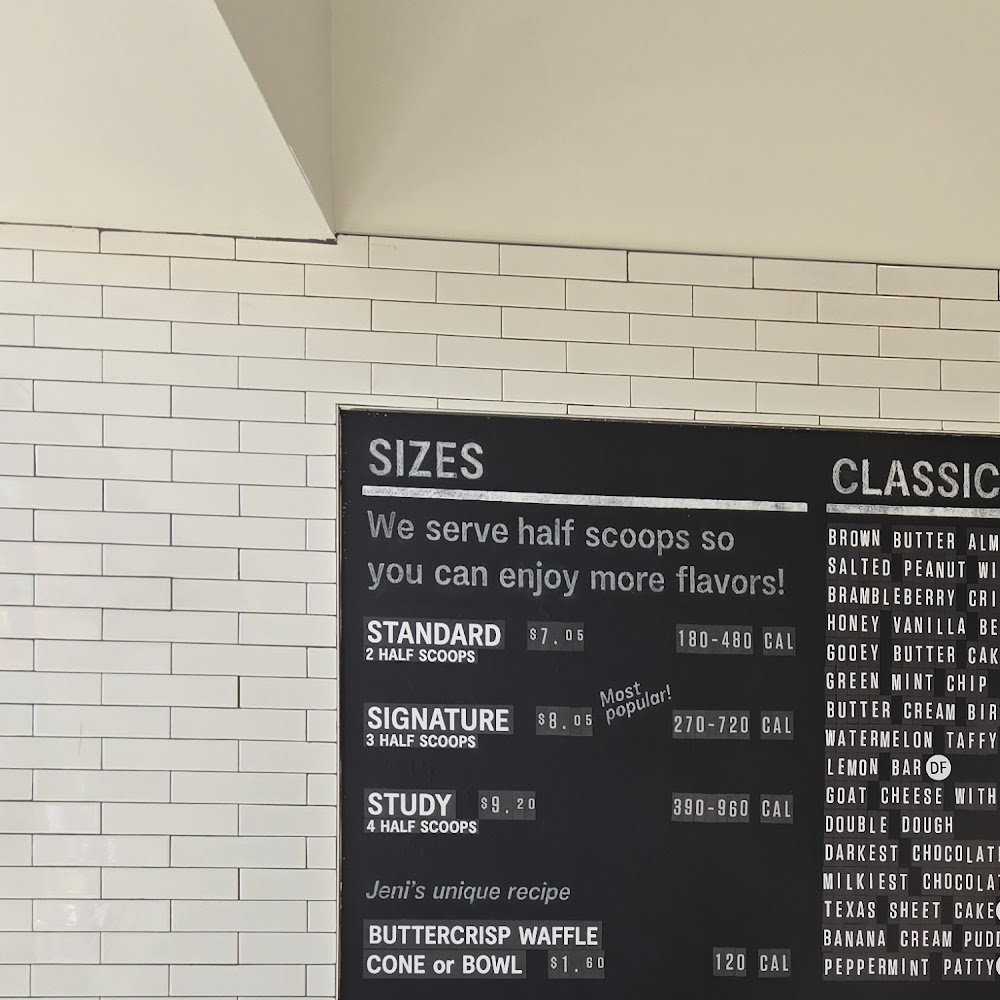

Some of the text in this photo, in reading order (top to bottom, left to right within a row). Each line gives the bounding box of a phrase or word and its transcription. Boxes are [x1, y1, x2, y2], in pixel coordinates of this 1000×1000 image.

[370, 438, 483, 479] SIZES
[833, 458, 999, 498] CLASSIC
[367, 511, 734, 555] We serve half scoops so
[829, 529, 879, 547] BROWN
[894, 532, 954, 549] BUTTER
[829, 557, 890, 575] SALTED
[905, 560, 965, 578] PEANUT
[368, 561, 784, 596] you can enjoy more flavors!
[829, 586, 954, 606] BRAMBLEBERRY
[368, 620, 501, 646] STANDARD
[828, 614, 878, 632] HONEY
[894, 617, 965, 634] VANILLA
[679, 630, 793, 649] 180-480 CAL
[366, 648, 475, 663] 2 HALF SCOOPS
[827, 644, 878, 661] GOOEY
[894, 645, 954, 662] BUTTER
[827, 672, 986, 692] GREEN MINT CHIP
[600, 682, 641, 709] Most
[606, 685, 672, 725] popular!
[368, 707, 509, 731] SIGNATURE
[827, 701, 890, 718] BUTTER
[904, 702, 955, 720] CREAM
[675, 716, 791, 733] 270-720 CAL
[366, 733, 476, 748] 3 HALF SCOOPS
[825, 729, 996, 749] WATERMELON TAFFY
[828, 758, 948, 776] LEMON BAR DF
[368, 792, 452, 816] STUDY
[826, 787, 866, 804] GOAT
[882, 787, 942, 804] CHEESE
[955, 788, 995, 804] WITH
[674, 799, 790, 817] 390-960 CAL
[367, 820, 477, 834] 4 HALF SCOOPS
[826, 816, 952, 833] DOUBLE DOUGH
[826, 844, 897, 862] DARKEST
[823, 873, 907, 890] MILKIEST
[366, 880, 570, 904] Jeni's unique recipe
[825, 901, 875, 918] TEXAS
[890, 901, 940, 918] SHEET
[955, 902, 994, 919] CAKE
[370, 925, 598, 945] BUTTERCRISP WAFFLE
[824, 929, 885, 947] BANANA
[901, 930, 952, 947] CREAM
[367, 955, 425, 974] CONE
[433, 960, 454, 974] or
[463, 955, 522, 974] BOWL
[716, 954, 788, 971] 120 CAL
[825, 958, 928, 976] PEPPERMINT
[944, 958, 994, 975] PATTY
